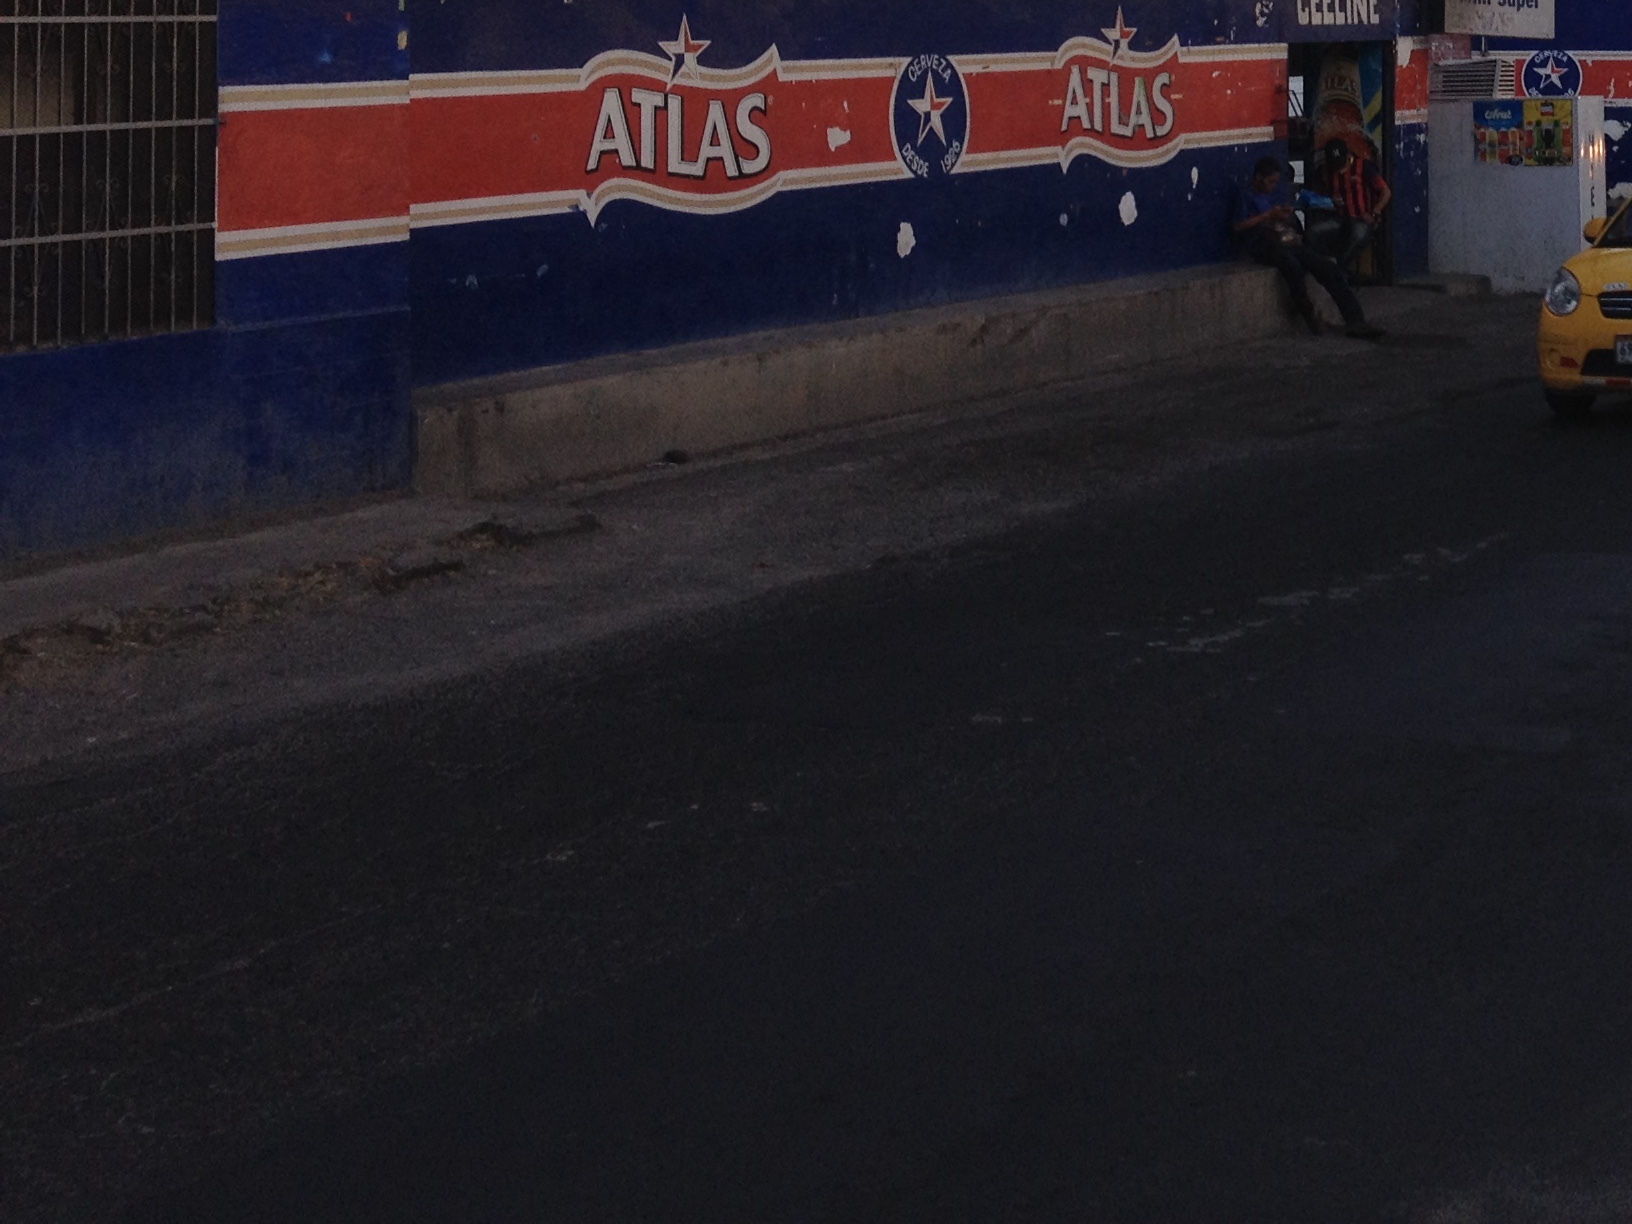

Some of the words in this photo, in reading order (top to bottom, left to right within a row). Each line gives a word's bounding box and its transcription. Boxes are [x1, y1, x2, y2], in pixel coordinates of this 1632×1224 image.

[908, 54, 952, 85] CERVEZA
[1533, 49, 1569, 64] CERVEZA
[1060, 64, 1175, 140] ATLAS
[586, 87, 772, 178] ATLAS
[901, 141, 930, 178] DESDE
